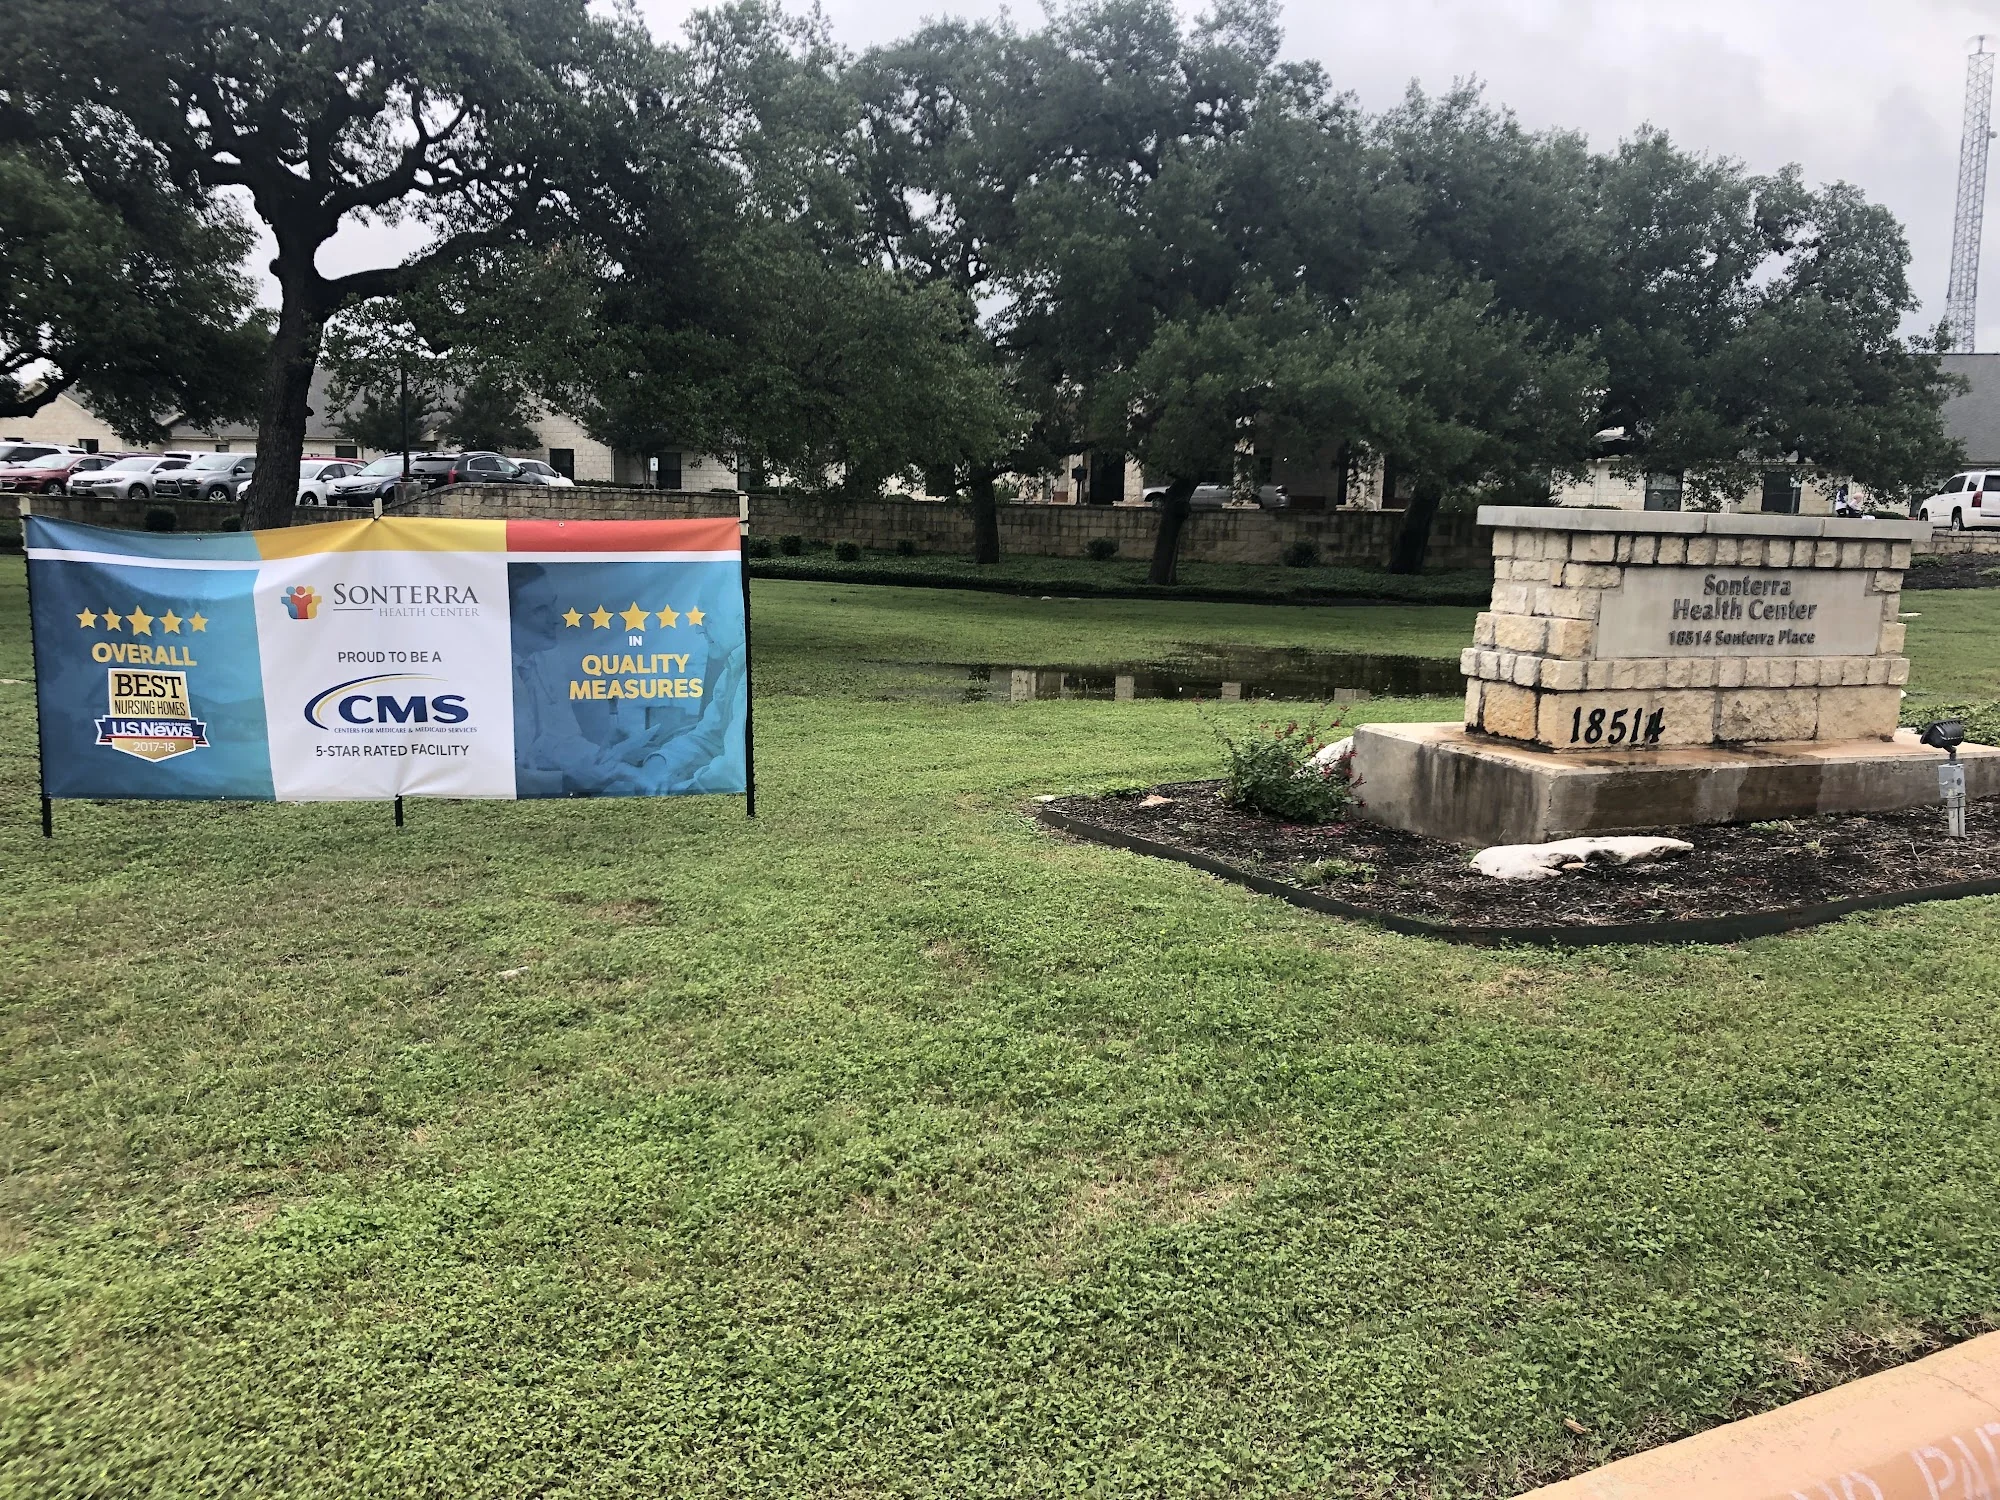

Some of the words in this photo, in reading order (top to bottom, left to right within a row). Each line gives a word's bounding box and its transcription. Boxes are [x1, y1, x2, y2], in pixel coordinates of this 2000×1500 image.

[333, 583, 480, 605] SONTERRA
[1703, 573, 1792, 596] Sonterra
[379, 607, 426, 617] HEALTH
[430, 607, 480, 617] CENTER
[1672, 597, 1743, 620] Health
[1749, 599, 1818, 620] Center
[629, 635, 643, 647] IN
[1668, 630, 1712, 646] 18514
[1715, 630, 1775, 646] Sonterra
[1778, 629, 1816, 644] Place
[91, 642, 197, 666] OVERALL
[337, 651, 386, 663] PROUD
[388, 651, 407, 663] TO
[410, 651, 429, 663] BE
[432, 651, 442, 663] A
[581, 653, 690, 676] QUALITY
[114, 673, 182, 699] BEST
[569, 678, 704, 700] MEASURES
[114, 699, 156, 715] NURSING
[157, 700, 186, 716] HOMES
[338, 694, 469, 724] CMS
[1570, 706, 1666, 745] 18514
[133, 742, 176, 752] 2017-18
[316, 745, 361, 757] 5-STAR
[363, 745, 408, 757] RATED
[411, 743, 470, 756] FACILITY
